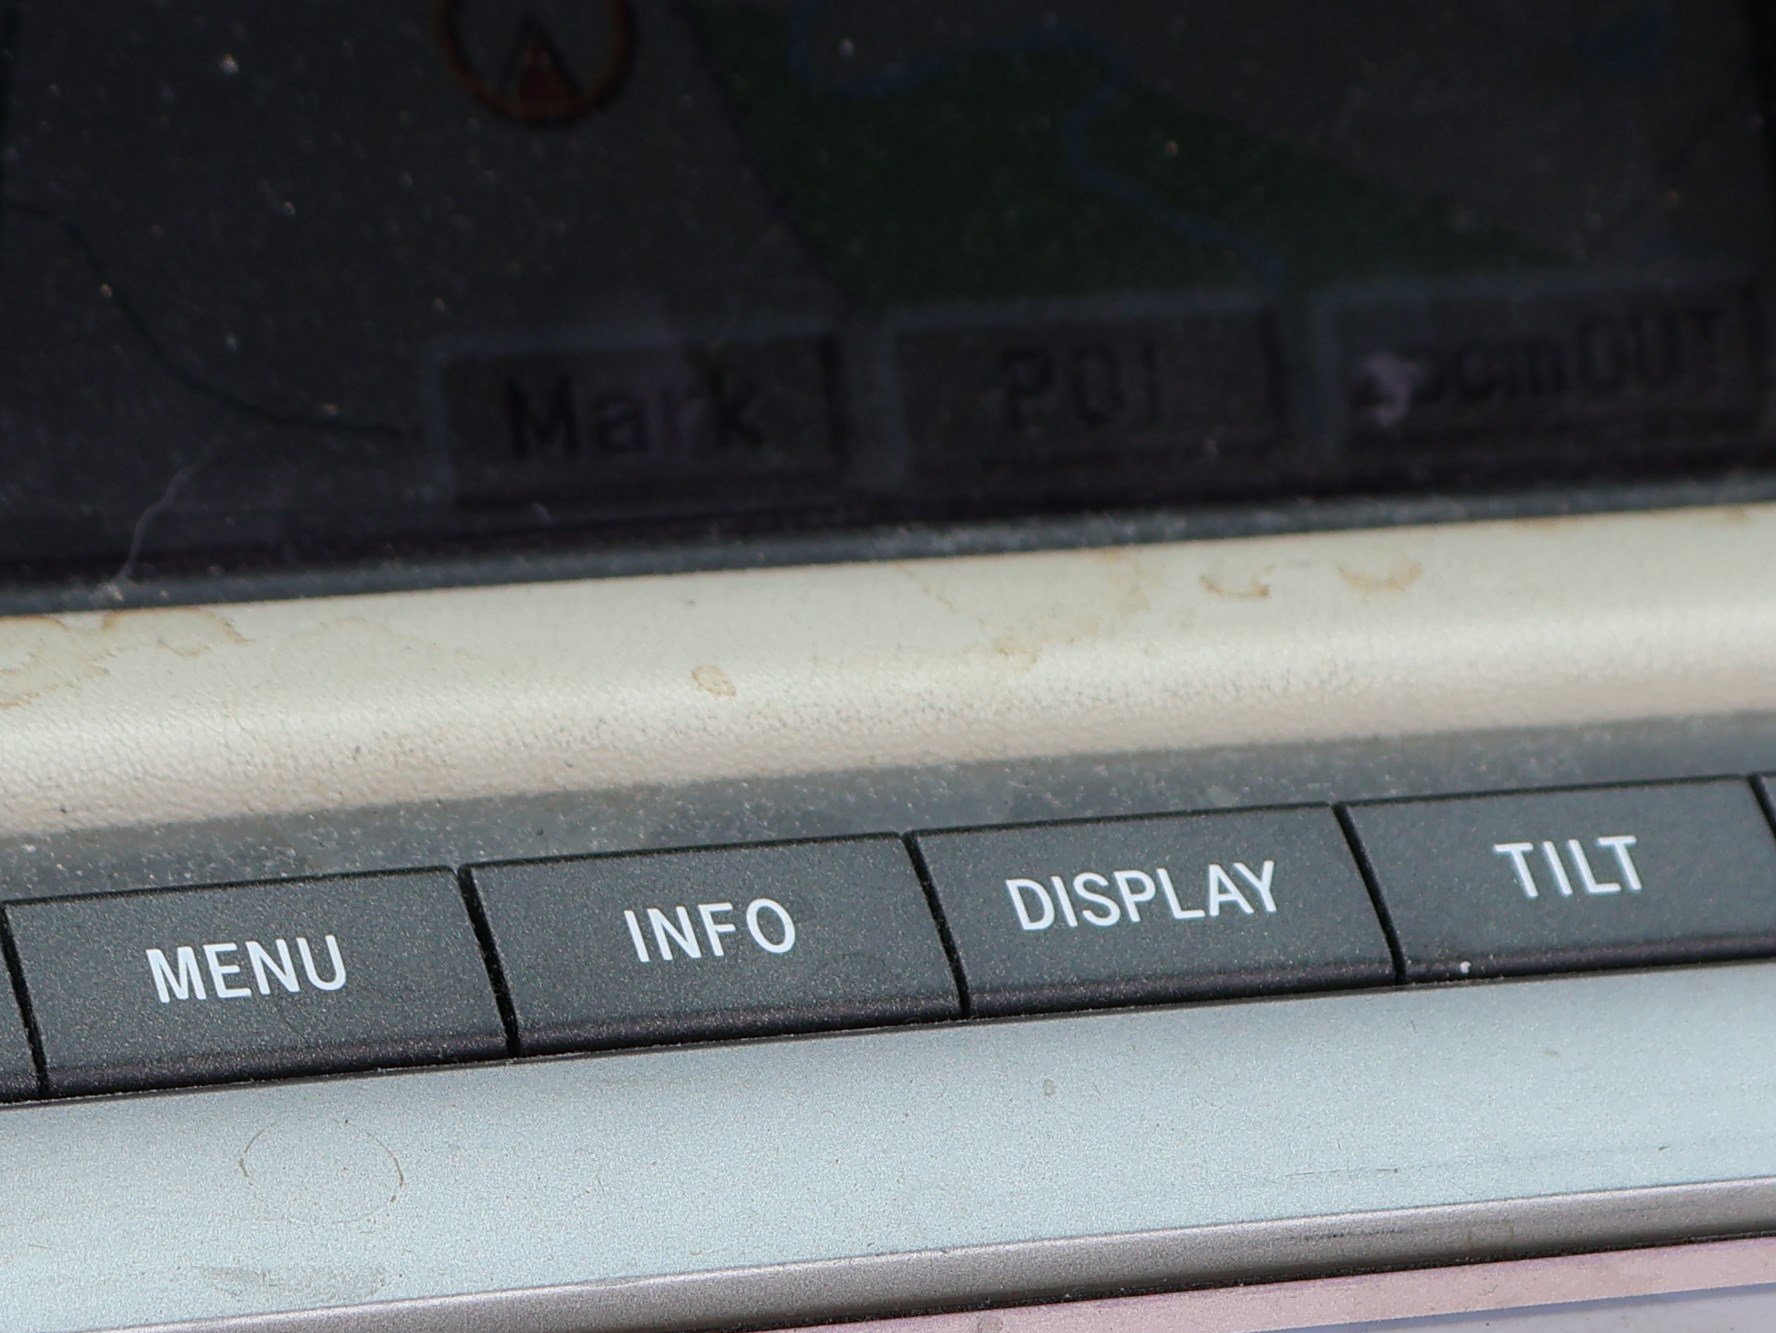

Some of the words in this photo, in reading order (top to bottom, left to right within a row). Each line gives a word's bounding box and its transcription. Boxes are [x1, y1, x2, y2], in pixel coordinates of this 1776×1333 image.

[1004, 859, 1278, 932] DISPLAY
[1495, 834, 1640, 900] TILT
[623, 896, 797, 964] INFO
[145, 934, 348, 1004] MENU
